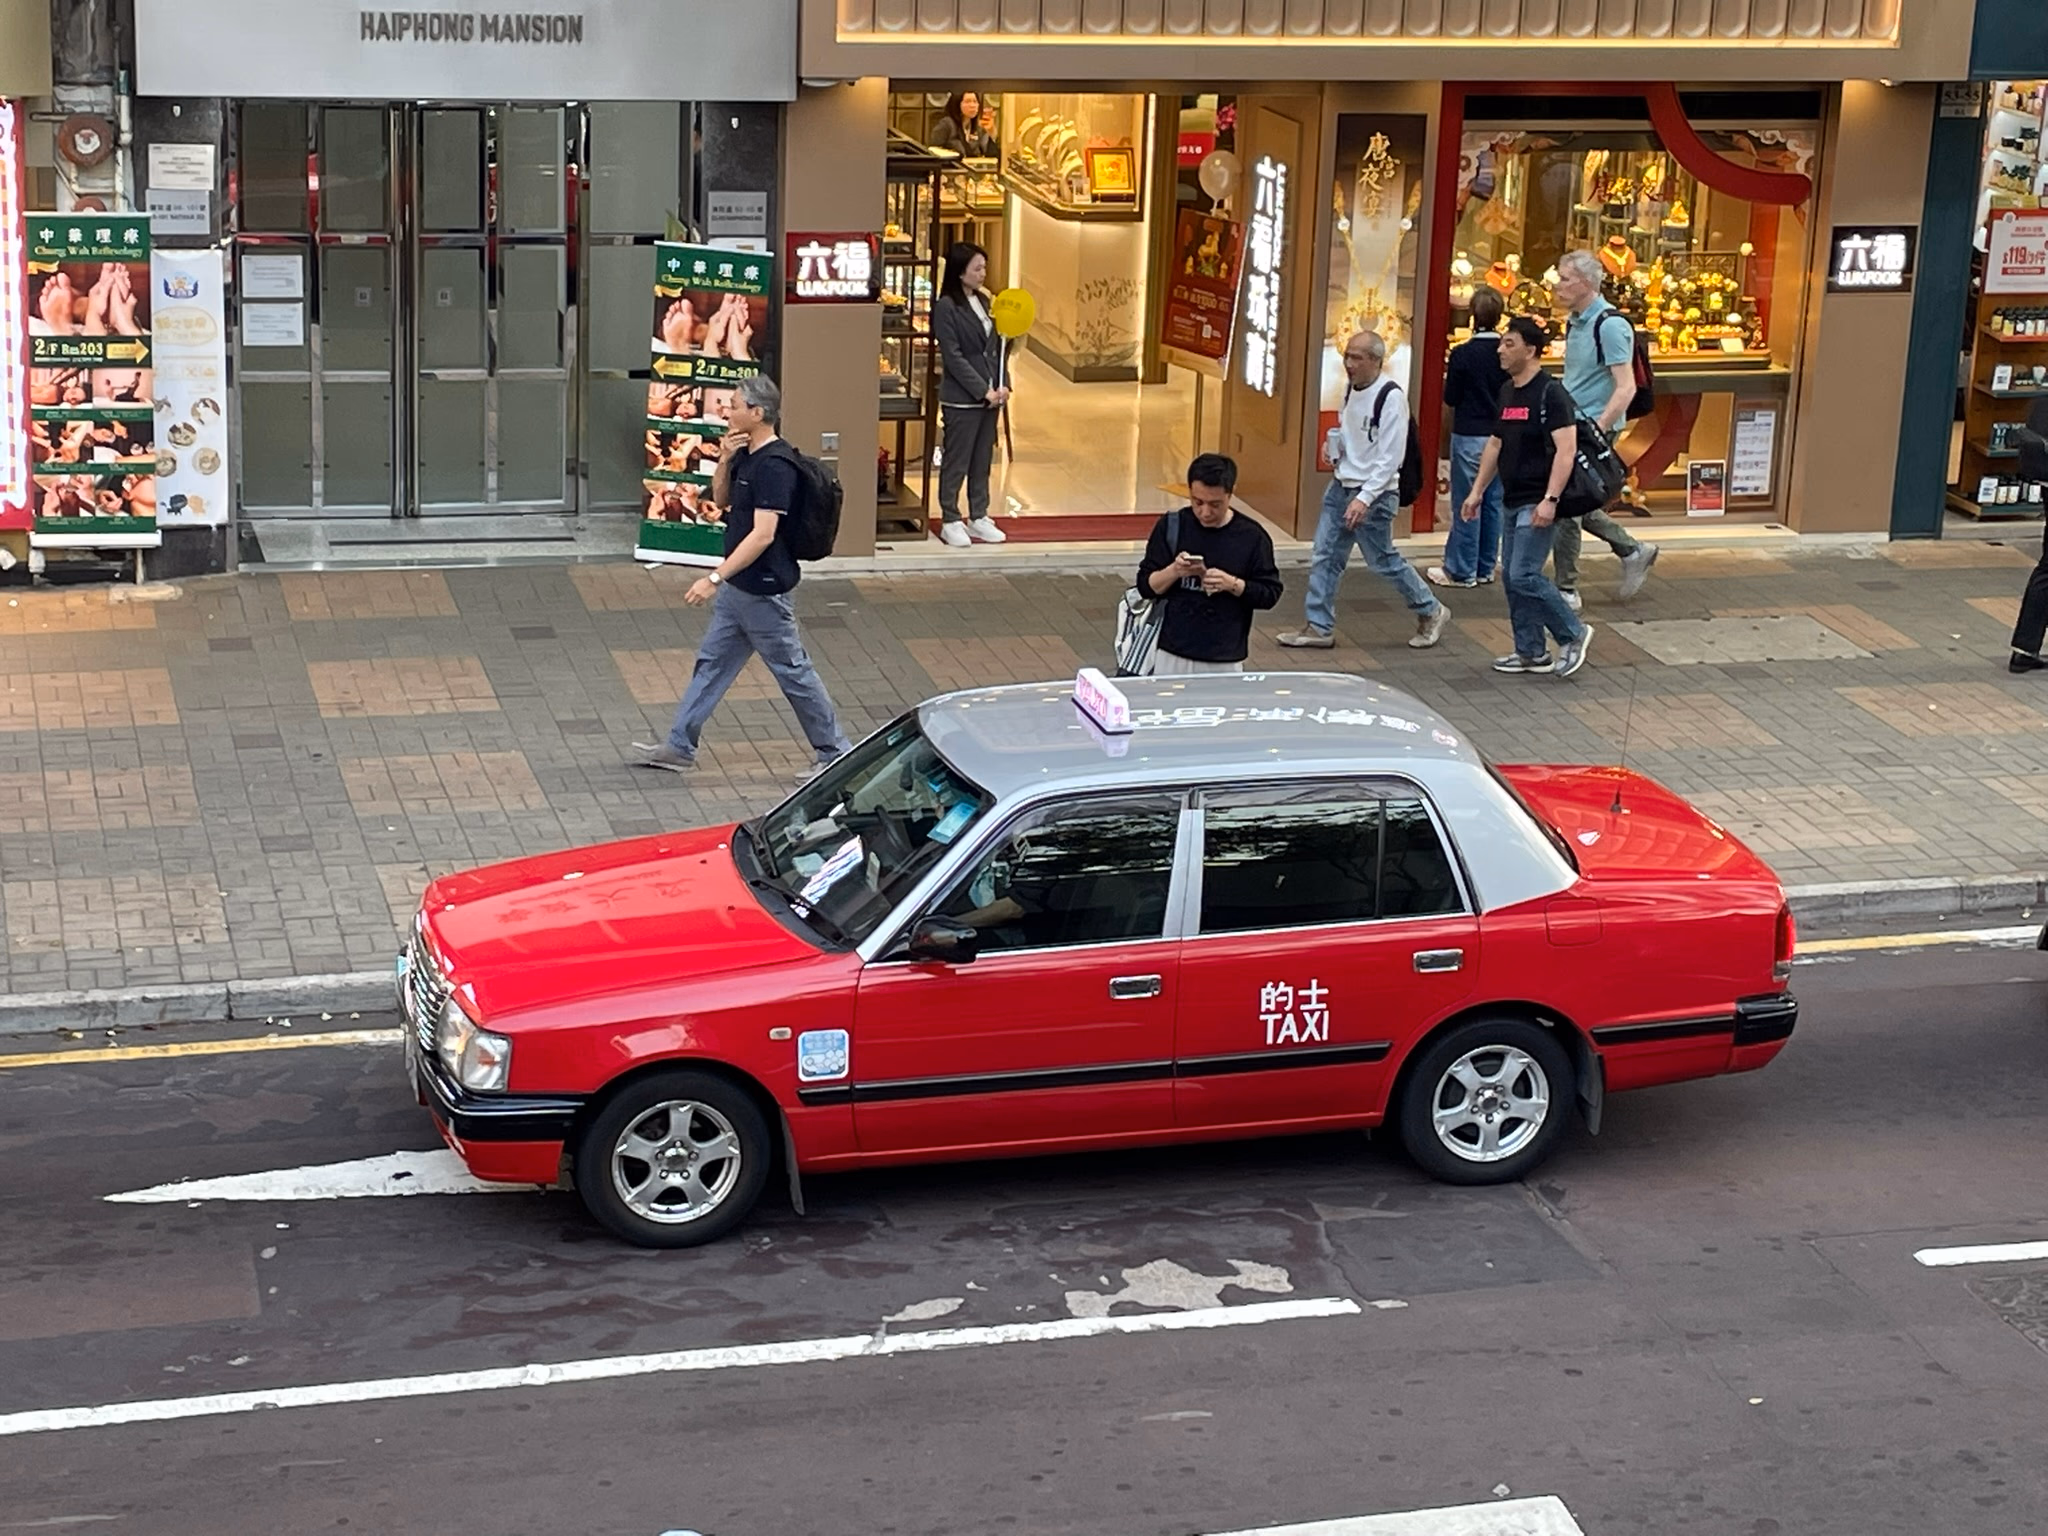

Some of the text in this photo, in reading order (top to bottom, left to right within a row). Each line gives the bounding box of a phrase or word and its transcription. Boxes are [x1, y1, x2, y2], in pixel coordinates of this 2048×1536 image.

[360, 11, 584, 44] HAIPHONG MANSION
[39, 227, 139, 244] 中華理療
[1840, 233, 1906, 271] 六福
[796, 240, 871, 280] 六福
[796, 280, 870, 297] LUKFOOK
[1838, 270, 1903, 287] LUKFOOK
[34, 338, 58, 356] 2/F
[61, 342, 104, 356] Rm203
[1260, 978, 1329, 1012] 的士
[1259, 1010, 1329, 1045] TAXI
